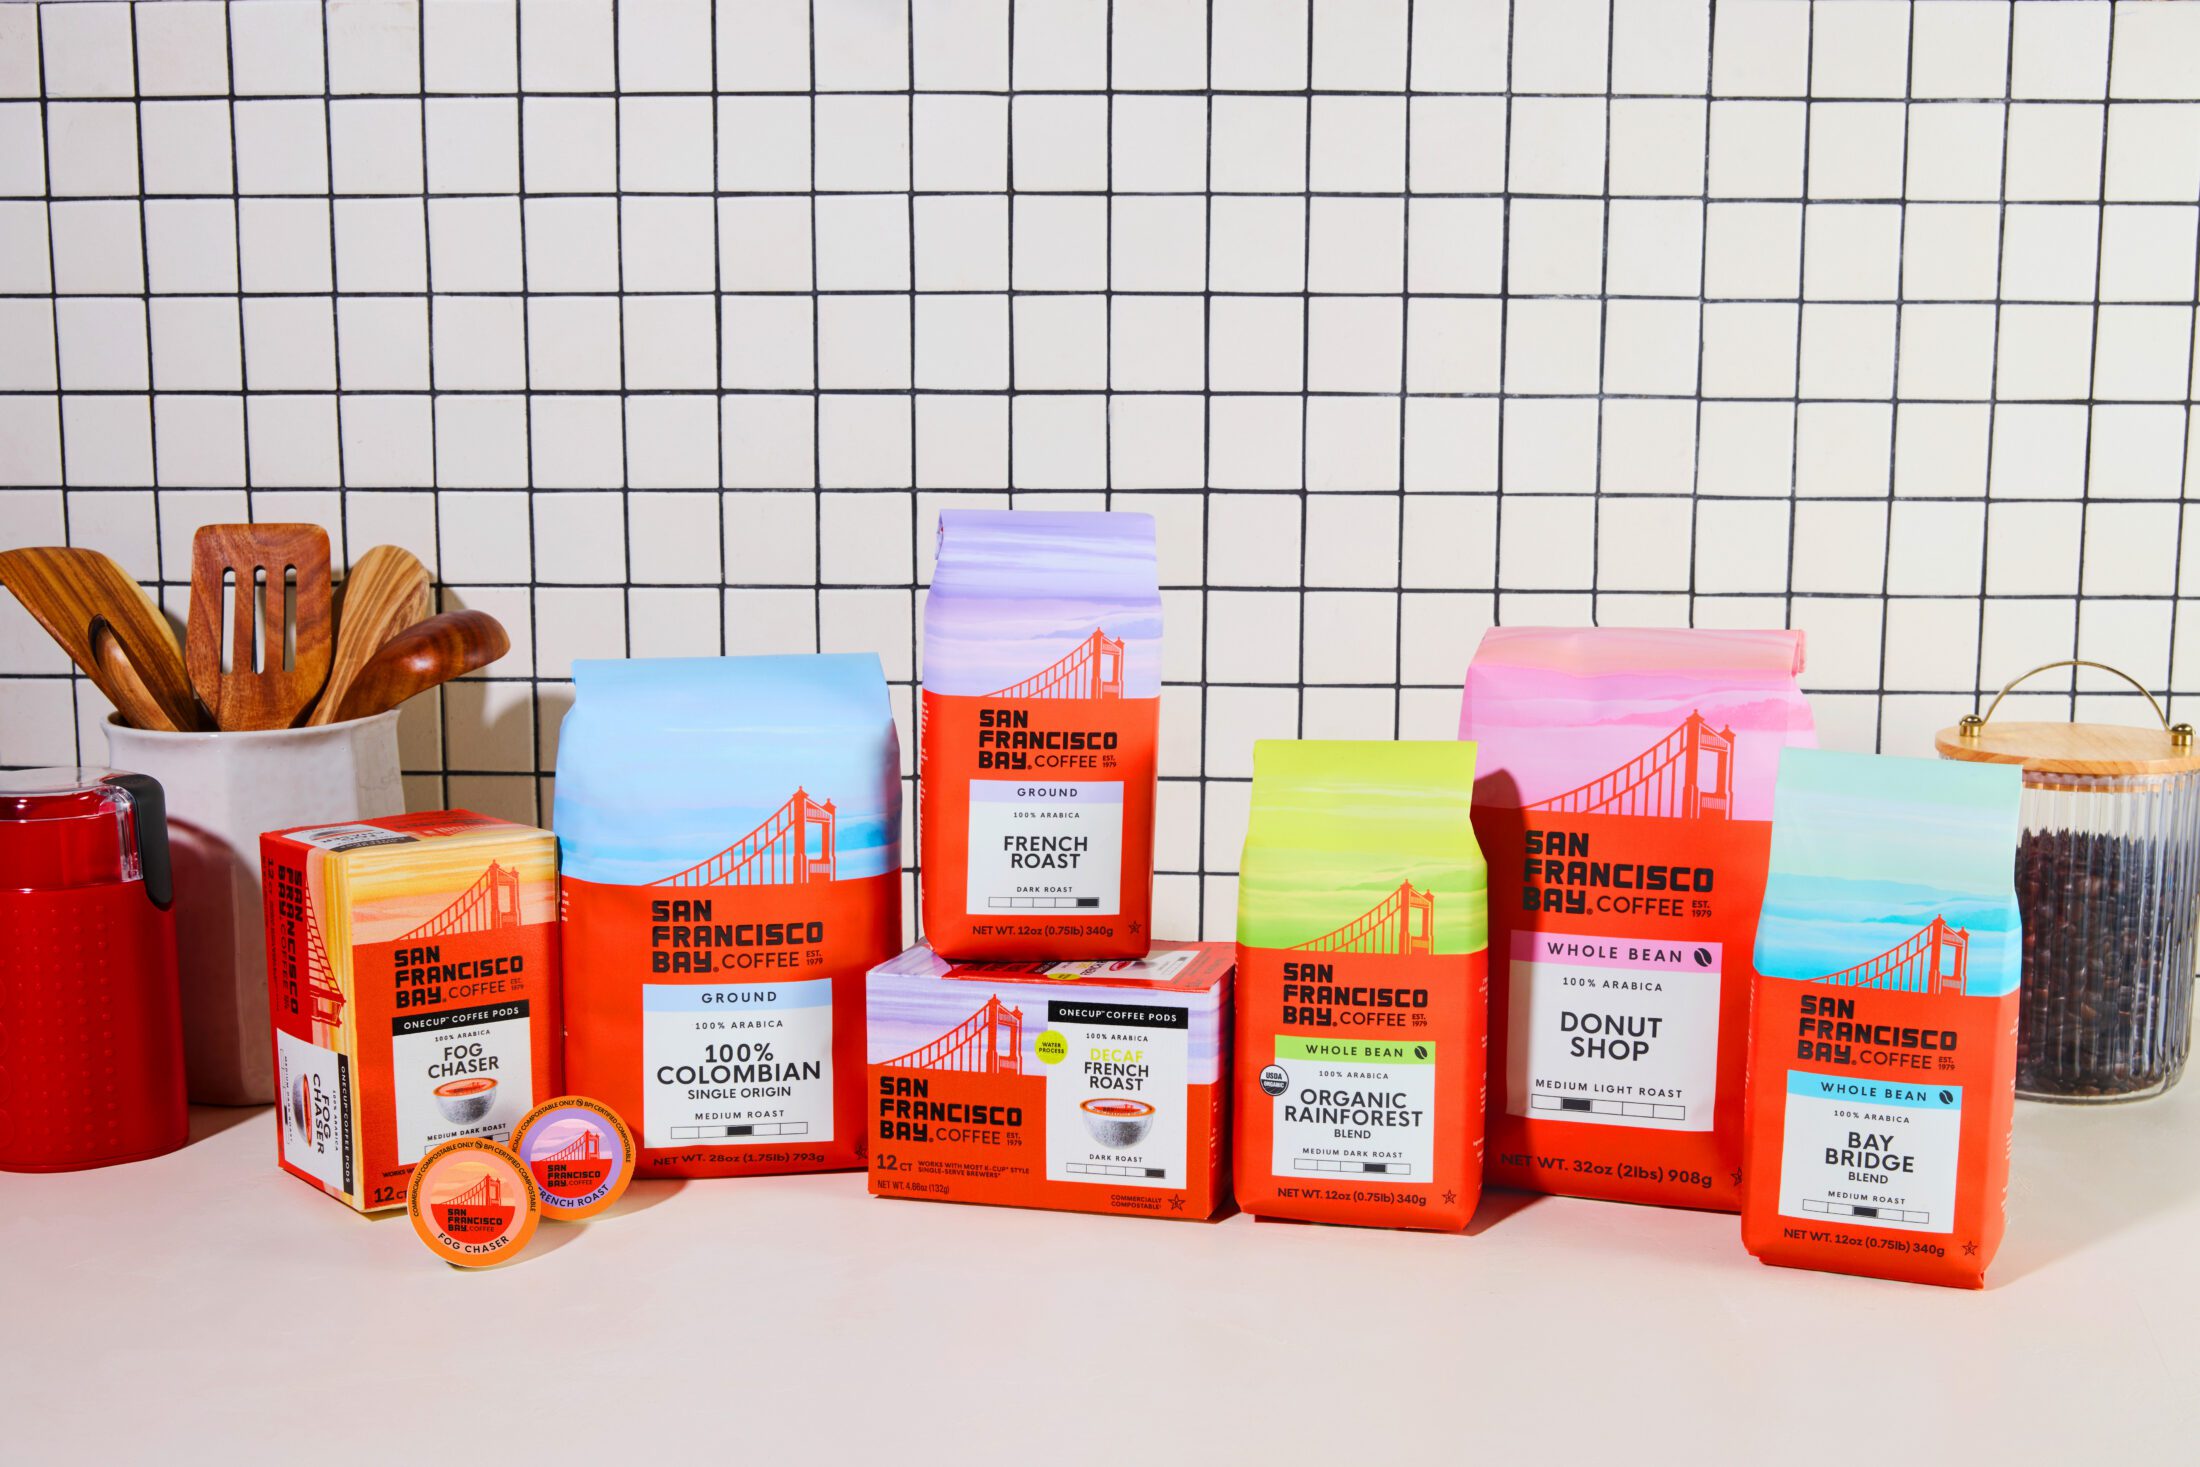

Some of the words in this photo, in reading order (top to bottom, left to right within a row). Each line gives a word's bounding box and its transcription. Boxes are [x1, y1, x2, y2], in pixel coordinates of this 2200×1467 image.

[980, 709, 1028, 728] SAN
[979, 730, 1117, 750] FRANCISCO
[1035, 755, 1097, 768] COFFEE
[1017, 788, 1077, 797] GROUND
[1004, 836, 1087, 851] FRENCH
[1525, 830, 1589, 857] SAN
[1012, 853, 1080, 868] ROAST
[1524, 861, 1714, 893] FRANCISCO
[652, 900, 711, 922] SAN
[1597, 896, 1683, 916] COFFEE
[652, 922, 823, 947] FRANCISCO
[973, 926, 993, 935] NET
[1018, 926, 1042, 935] 12oz
[1045, 925, 1084, 937] (0.75lb)
[1086, 926, 1113, 937] 340g
[395, 946, 440, 967] SAN
[722, 952, 799, 969] COFFEE
[1548, 942, 1617, 959] WHOLE
[1629, 948, 1681, 962] BEAN
[396, 956, 522, 988] FRANCISCO
[1284, 963, 1333, 983] SAN
[449, 980, 505, 998] COFFEE
[1563, 977, 1595, 987] 100%
[1603, 980, 1662, 991] ARABICA
[702, 992, 776, 1003] GROUND
[1284, 984, 1428, 1007] FRANCISCO
[452, 1011, 488, 1023] COFFEE
[493, 1007, 518, 1017] PODS
[1801, 995, 1854, 1019] SAN
[696, 1022, 725, 1030] 100%
[731, 1020, 783, 1028] ARABICA
[1106, 1011, 1144, 1020] COFFEE
[1149, 1013, 1176, 1022] PODS
[1340, 1012, 1406, 1026] COFFEE
[458, 1030, 490, 1038] ARABICA
[1561, 1011, 1662, 1042] DONUT
[1799, 1018, 1957, 1050] FRANCISCO
[445, 1043, 482, 1061] FOG
[706, 1043, 773, 1063] 100%
[1090, 1048, 1142, 1062] DECAF
[1306, 1045, 1357, 1055] WHOLE
[1365, 1047, 1402, 1057] BEAN
[1571, 1037, 1649, 1061] SHOP
[428, 1056, 499, 1080] CHASER
[1860, 1050, 1932, 1069] COFFEE
[657, 1061, 820, 1084] COLOMBIAN
[1085, 1062, 1148, 1077] FRENCH
[1266, 1072, 1282, 1080] USDA
[688, 1089, 736, 1099] SINGLE
[741, 1086, 791, 1098] ORIGIN
[880, 1076, 928, 1098] SAN
[1090, 1076, 1143, 1091] ROAST
[1536, 1079, 1587, 1091] MEDIUM
[1594, 1084, 1632, 1094] LIGHT
[1639, 1088, 1682, 1098] ROAST
[1821, 1082, 1876, 1096] WHOLE
[1885, 1089, 1926, 1101] BEAN
[1301, 1089, 1406, 1108] ORGANIC
[695, 1112, 741, 1120] MEDIUM
[747, 1110, 784, 1118] ROAST
[880, 1098, 1022, 1126] FRANCISCO
[1285, 1106, 1423, 1127] RAINFOREST
[1835, 1110, 1859, 1118] 100%
[1864, 1114, 1909, 1123] ARABICA
[427, 1132, 458, 1142] MEDIUM
[483, 1123, 505, 1131] ROAST
[936, 1128, 1000, 1144] COFFEE
[1334, 1129, 1371, 1139] BLEND
[1848, 1132, 1894, 1151] BAY
[653, 1157, 677, 1166] NET
[710, 1154, 739, 1162] 28oz
[743, 1153, 790, 1163] (1.75lb)
[794, 1153, 824, 1162] 793g
[877, 1154, 897, 1170] 12
[900, 1163, 912, 1171] CT
[1826, 1148, 1914, 1173] BRIDGE
[548, 1171, 600, 1179] FRANCISCO
[1501, 1153, 1531, 1166] NET
[1574, 1160, 1613, 1175] 32oz
[1618, 1163, 1663, 1183] (2lbs)
[1668, 1170, 1712, 1188] 908g
[1849, 1172, 1888, 1184] BLEND
[414, 1172, 422, 1216] COMMERCIALLY
[421, 1145, 457, 1172] COMPOSTABLE
[494, 1148, 520, 1169] CERTIFIED
[519, 1167, 536, 1212] COMPOSTABLE
[878, 1180, 890, 1188] NET
[374, 1186, 394, 1203] 12
[578, 1184, 608, 1206] ROAST
[1278, 1188, 1299, 1197] NET
[1326, 1190, 1351, 1200] 12oz
[1353, 1191, 1394, 1204] (0.75lb)
[1397, 1194, 1426, 1206] 340g
[1828, 1191, 1868, 1200] MEDIUM
[1873, 1196, 1905, 1204] ROAST
[448, 1208, 466, 1216] SAN
[448, 1216, 502, 1225] FRANCISCO
[438, 1233, 460, 1249] FOG
[465, 1236, 509, 1253] CHASER
[1784, 1228, 1807, 1239] NET
[1835, 1234, 1862, 1246] 12oz
[1865, 1237, 1910, 1253] (0.75lb)
[1913, 1243, 1944, 1257] 340g
